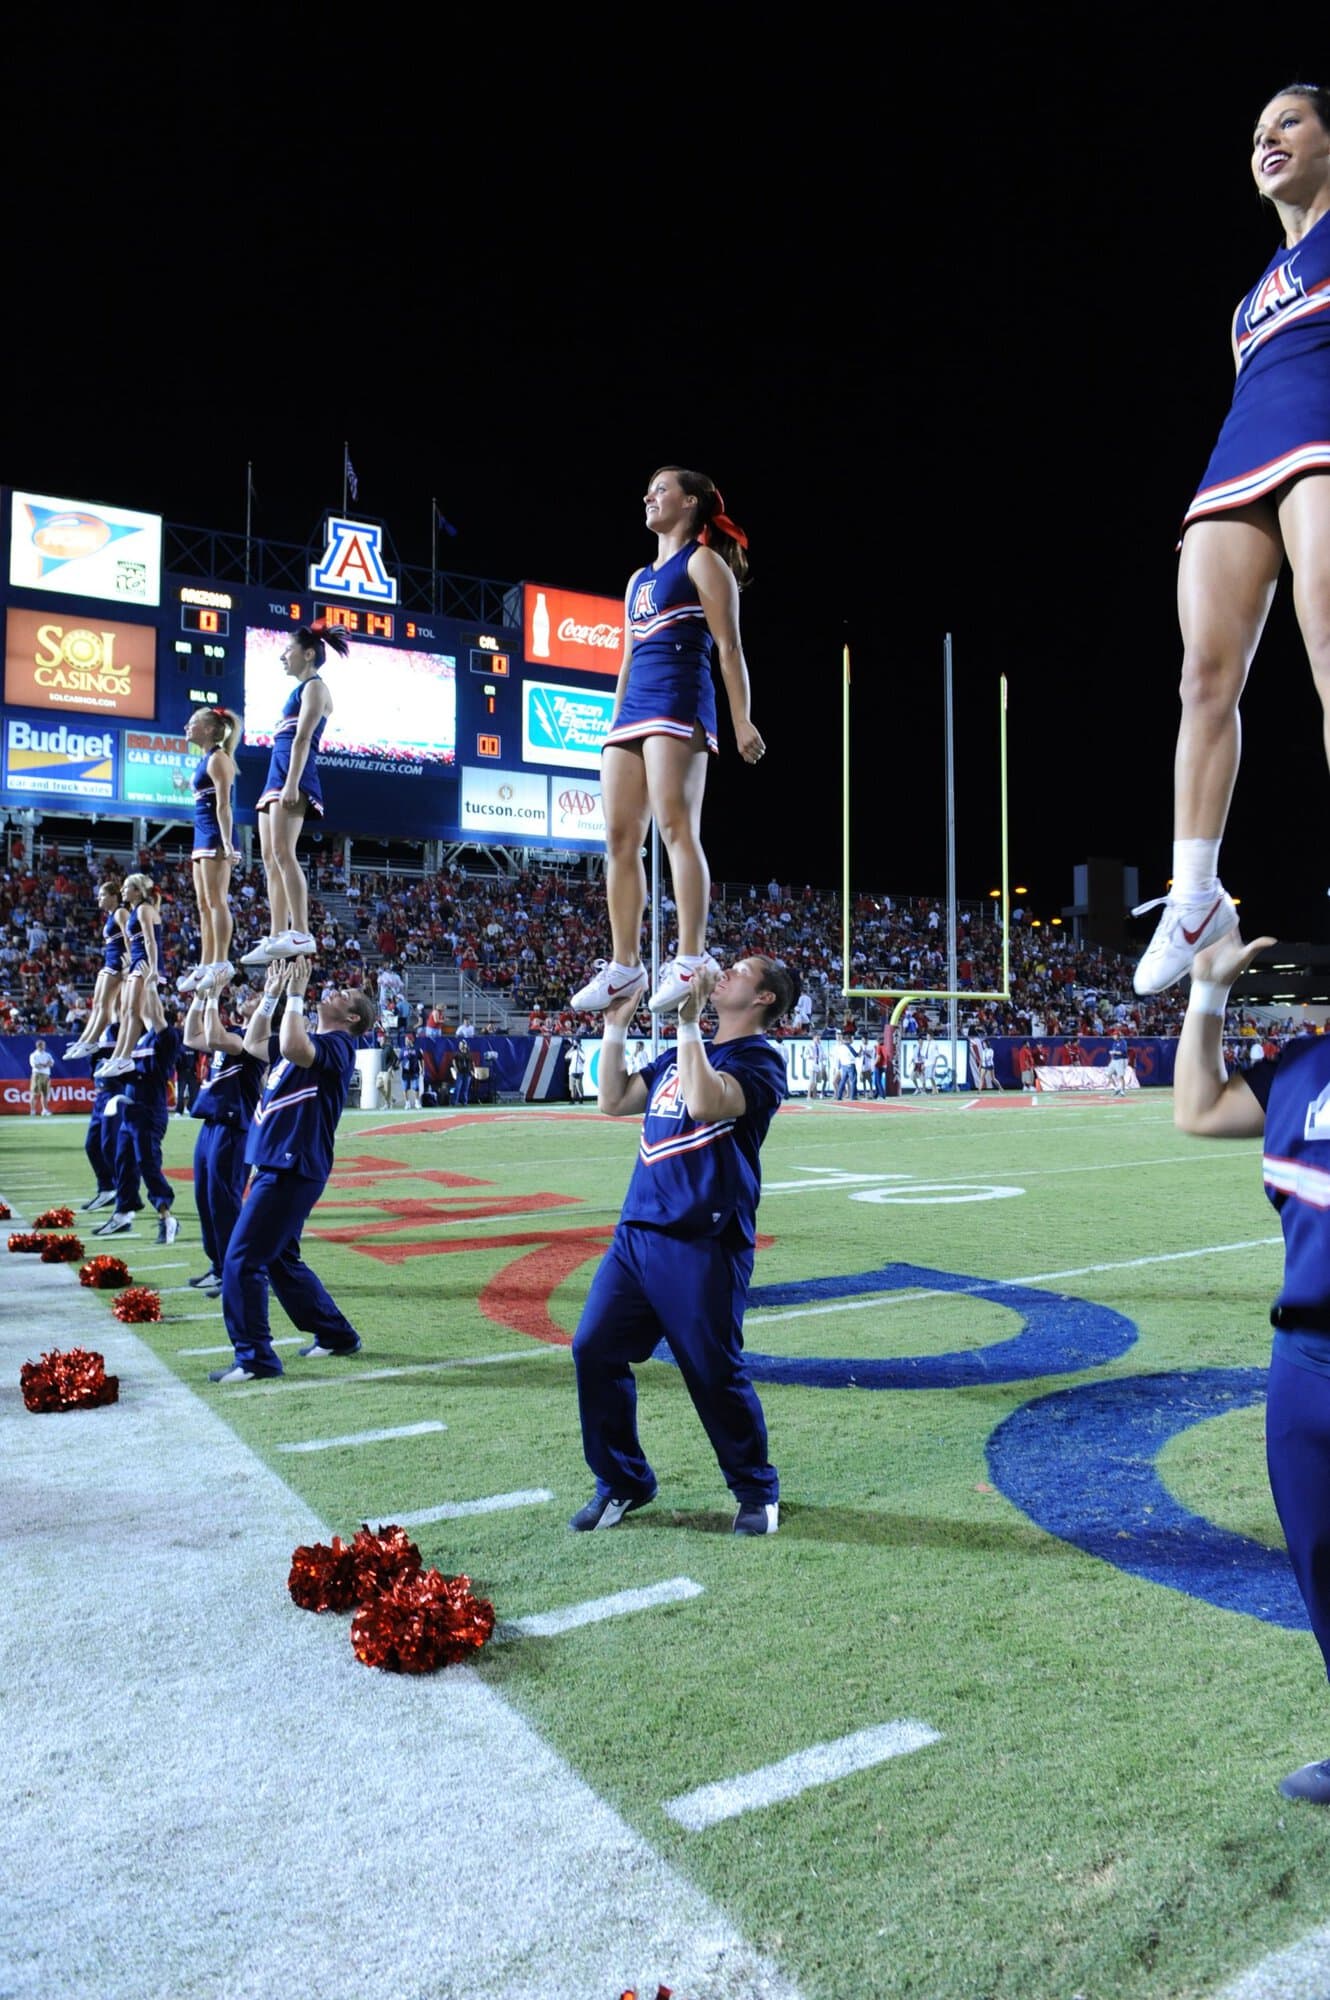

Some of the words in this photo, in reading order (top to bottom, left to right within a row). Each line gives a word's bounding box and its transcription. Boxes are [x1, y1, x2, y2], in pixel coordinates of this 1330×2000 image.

[1245, 252, 1307, 334] A
[309, 517, 397, 604] A
[269, 603, 288, 615] TOL
[290, 604, 300, 620] 3
[629, 580, 659, 625] A
[200, 610, 218, 632] 0
[406, 622, 416, 639] 3
[417, 627, 435, 639] TOL
[35, 624, 131, 676] SOL
[34, 667, 132, 695] CASINOS
[553, 696, 604, 719] Tucson
[558, 712, 612, 733] Electri
[8, 720, 114, 763] Budget
[563, 728, 607, 748] Powe
[128, 751, 150, 764] CAR
[153, 753, 181, 767] CARE
[314, 755, 423, 775] ZONAATHLETICS.COM
[32, 779, 49, 790] and
[52, 781, 79, 792] truck
[465, 800, 546, 820] tucson.com
[3, 1087, 33, 1103] Go
[47, 1086, 100, 1102] Wildc
